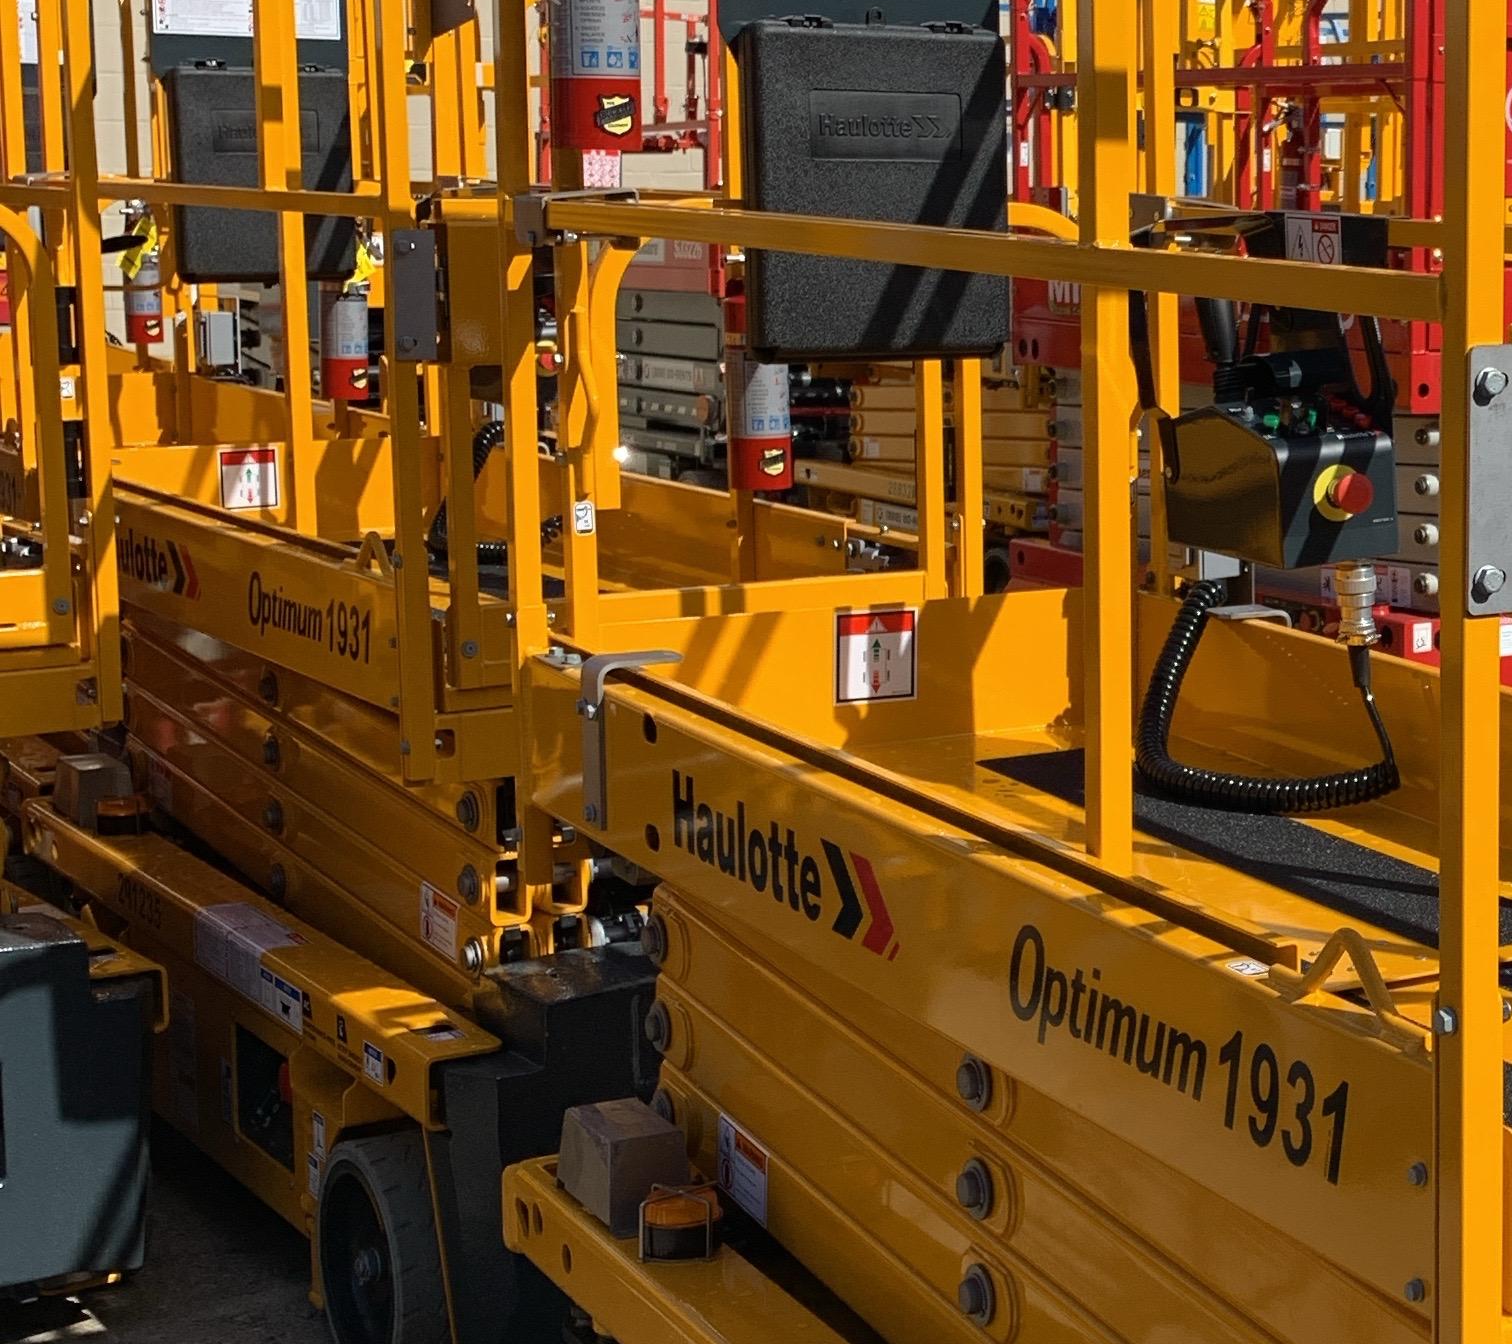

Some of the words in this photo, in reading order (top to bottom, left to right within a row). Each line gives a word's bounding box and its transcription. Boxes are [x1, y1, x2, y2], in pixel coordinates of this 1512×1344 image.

[818, 112, 912, 138] Haulotte
[118, 529, 168, 583] ulotte
[248, 571, 323, 643] Optimum
[325, 599, 372, 665] 1931
[671, 769, 823, 923] Haulotte
[1008, 925, 1208, 1104] Optimum
[1218, 1031, 1350, 1186] 1931
